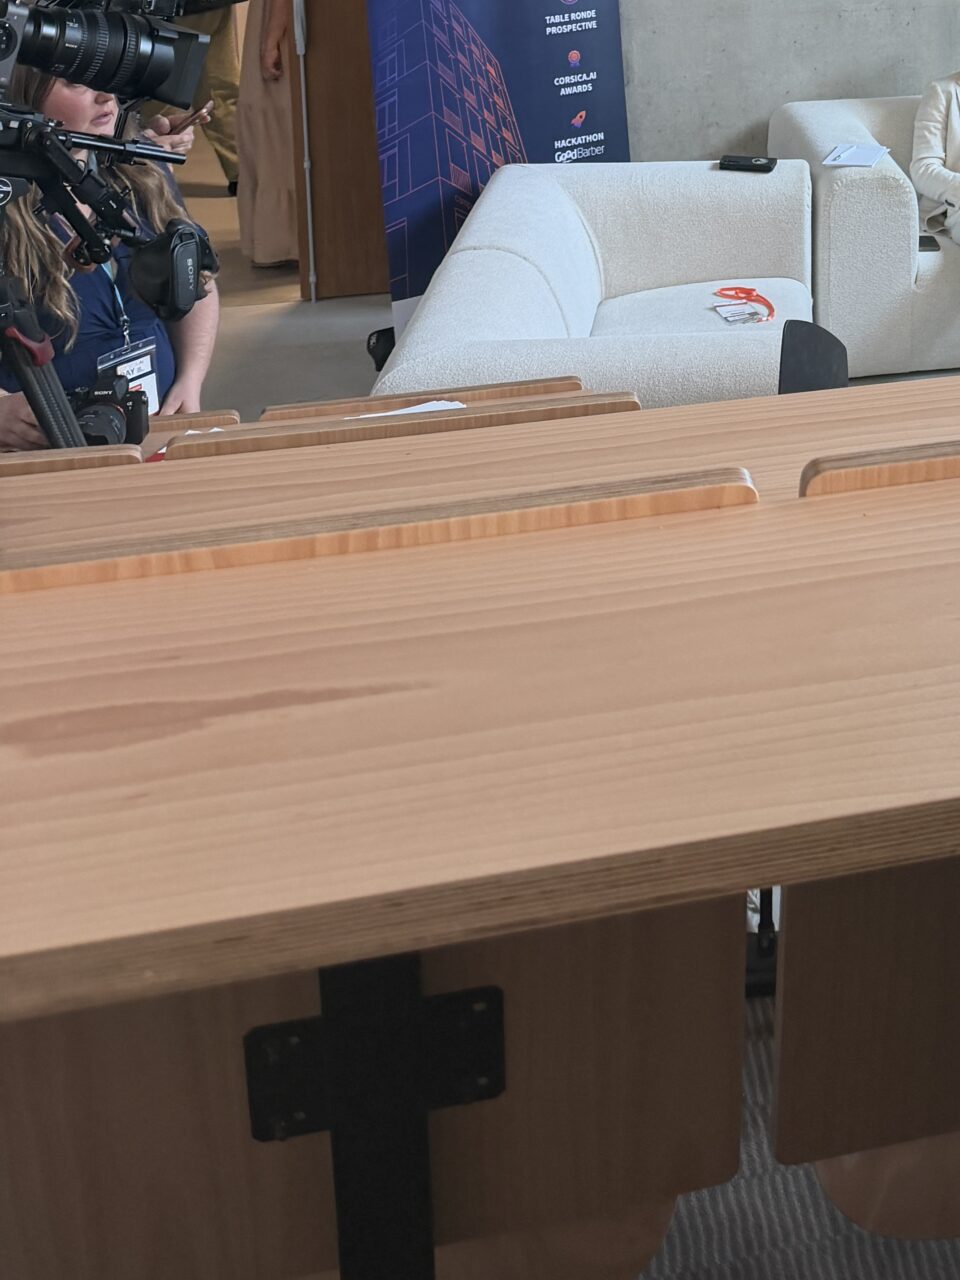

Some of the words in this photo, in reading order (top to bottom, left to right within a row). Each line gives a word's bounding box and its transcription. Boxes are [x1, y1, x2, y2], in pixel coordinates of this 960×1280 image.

[545, 14, 569, 24] TABLE
[571, 9, 597, 20] RONDE
[546, 21, 598, 35] PROSPECTIVE
[554, 72, 597, 85] CORSICA.AI
[560, 83, 593, 96] AWARDS
[554, 132, 604, 149] HACKATHON
